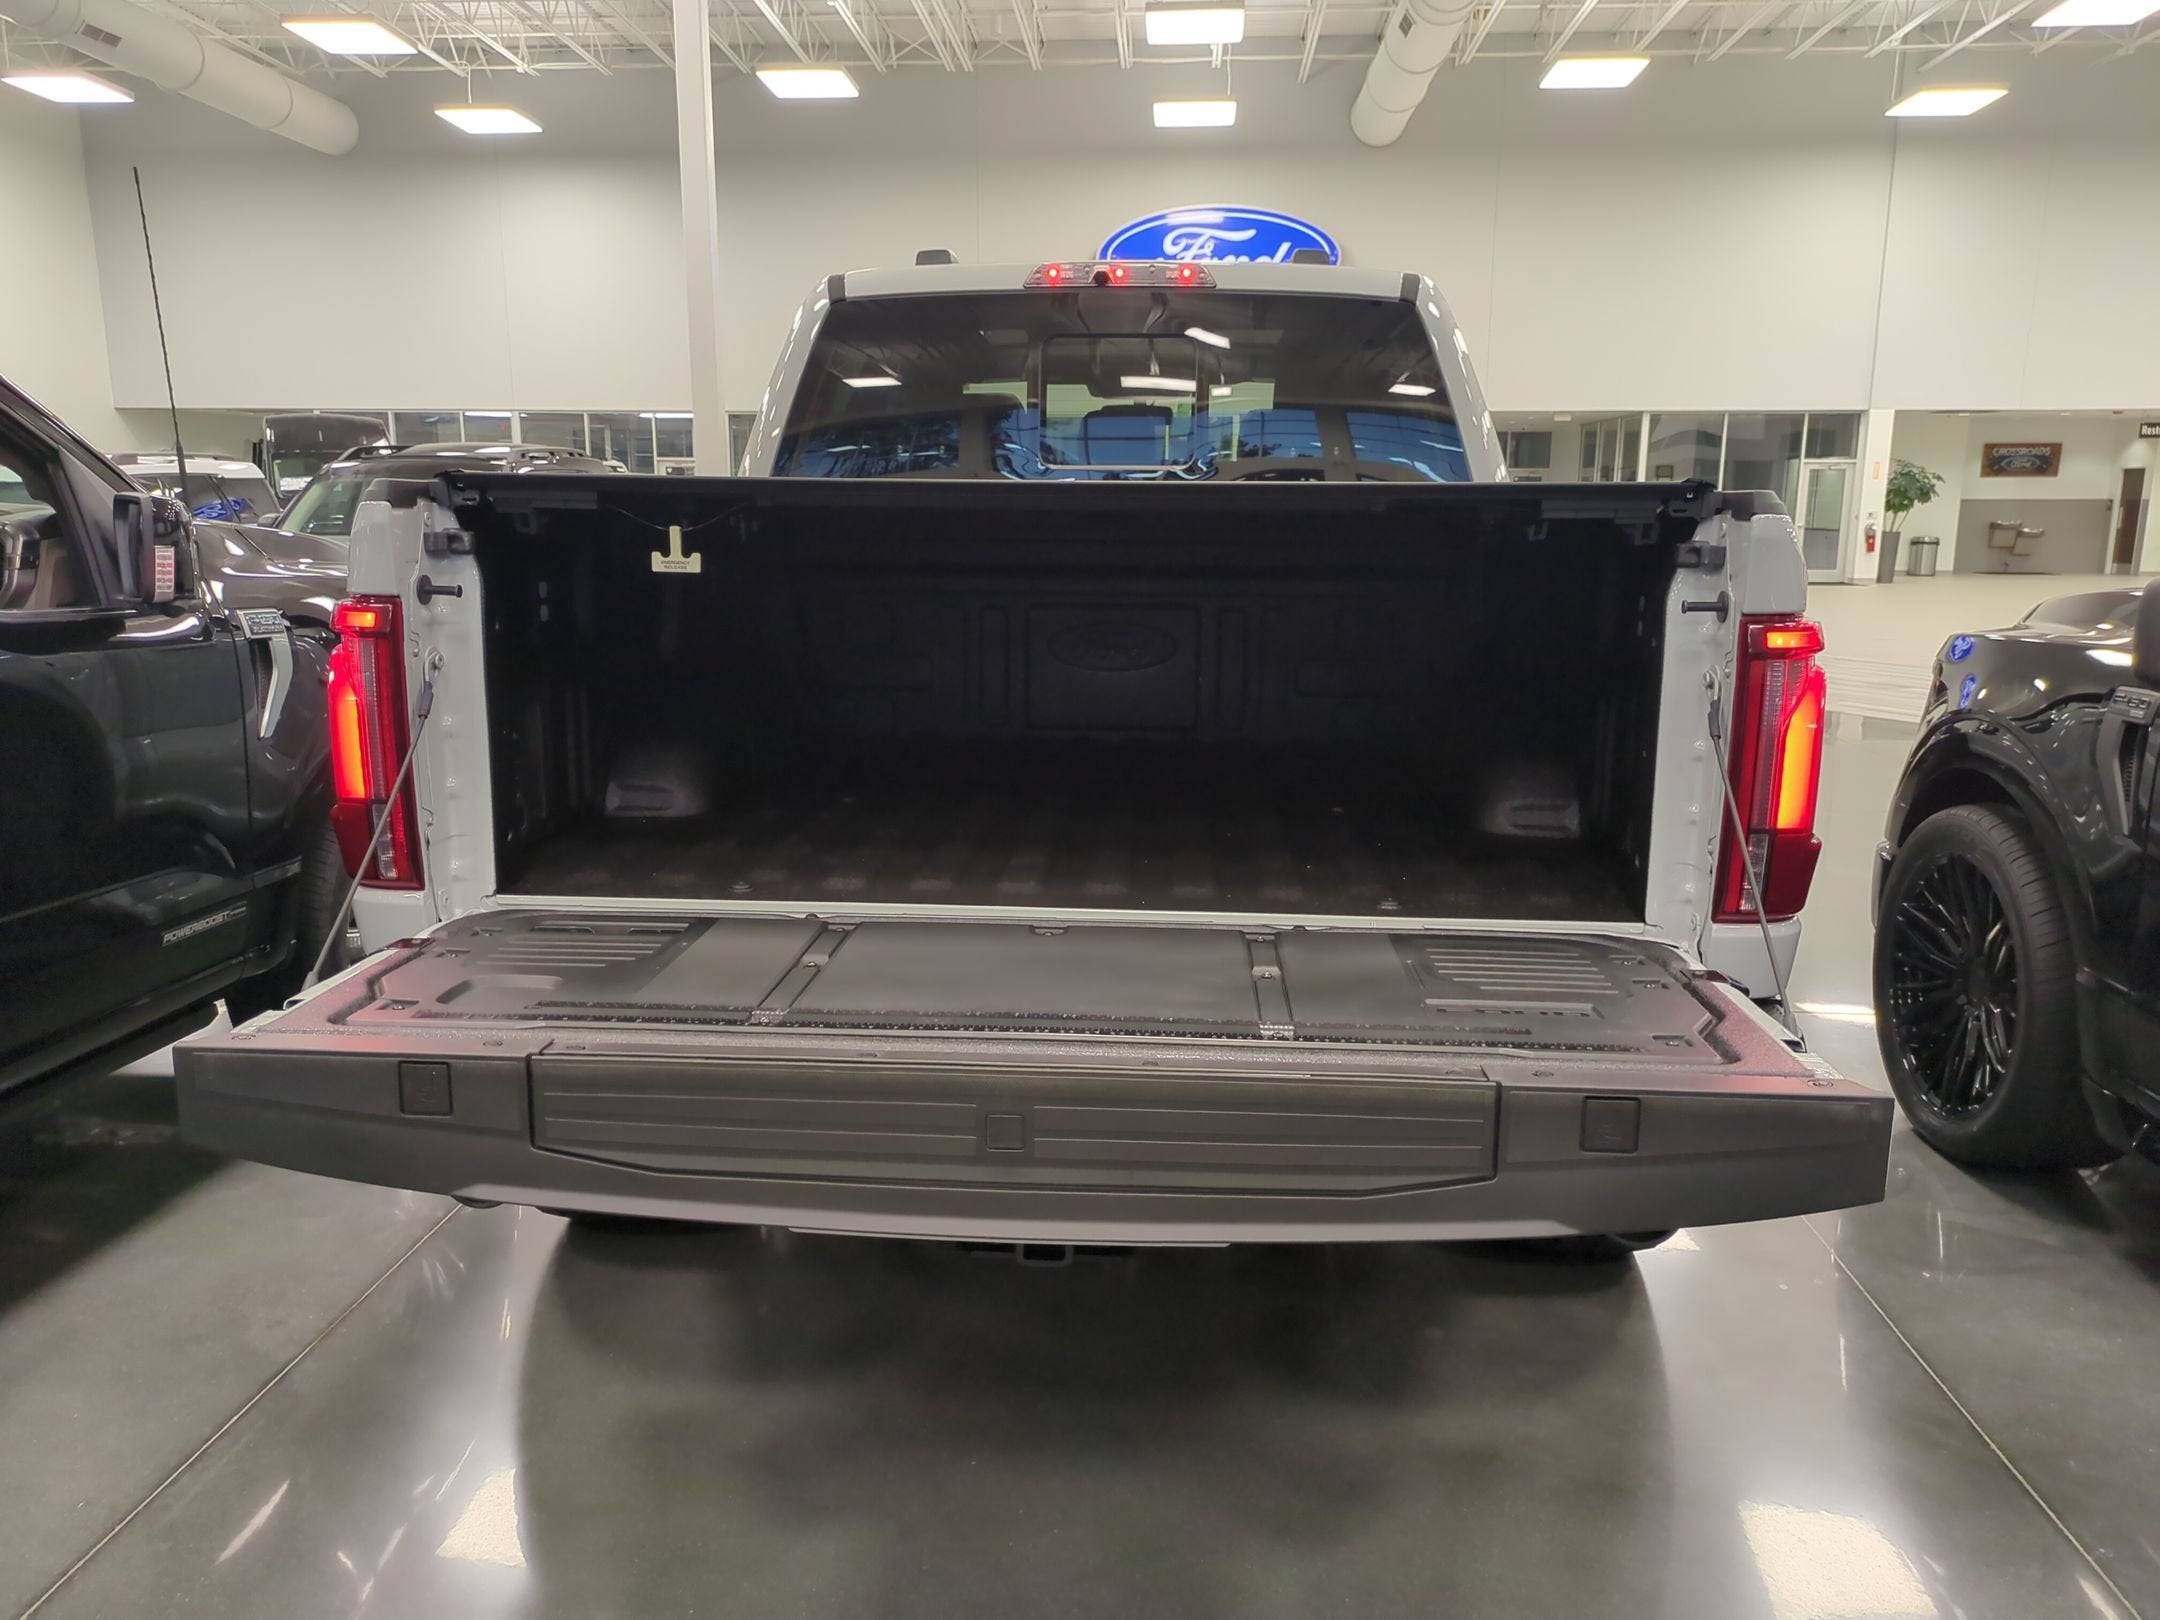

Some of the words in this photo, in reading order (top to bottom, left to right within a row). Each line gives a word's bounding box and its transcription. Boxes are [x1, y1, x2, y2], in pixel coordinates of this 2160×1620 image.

[1155, 227, 1292, 264] Fd
[2141, 425, 2160, 436] Rest
[1992, 447, 2051, 457] CROSSROADS
[162, 910, 231, 944] POWERBOOST
